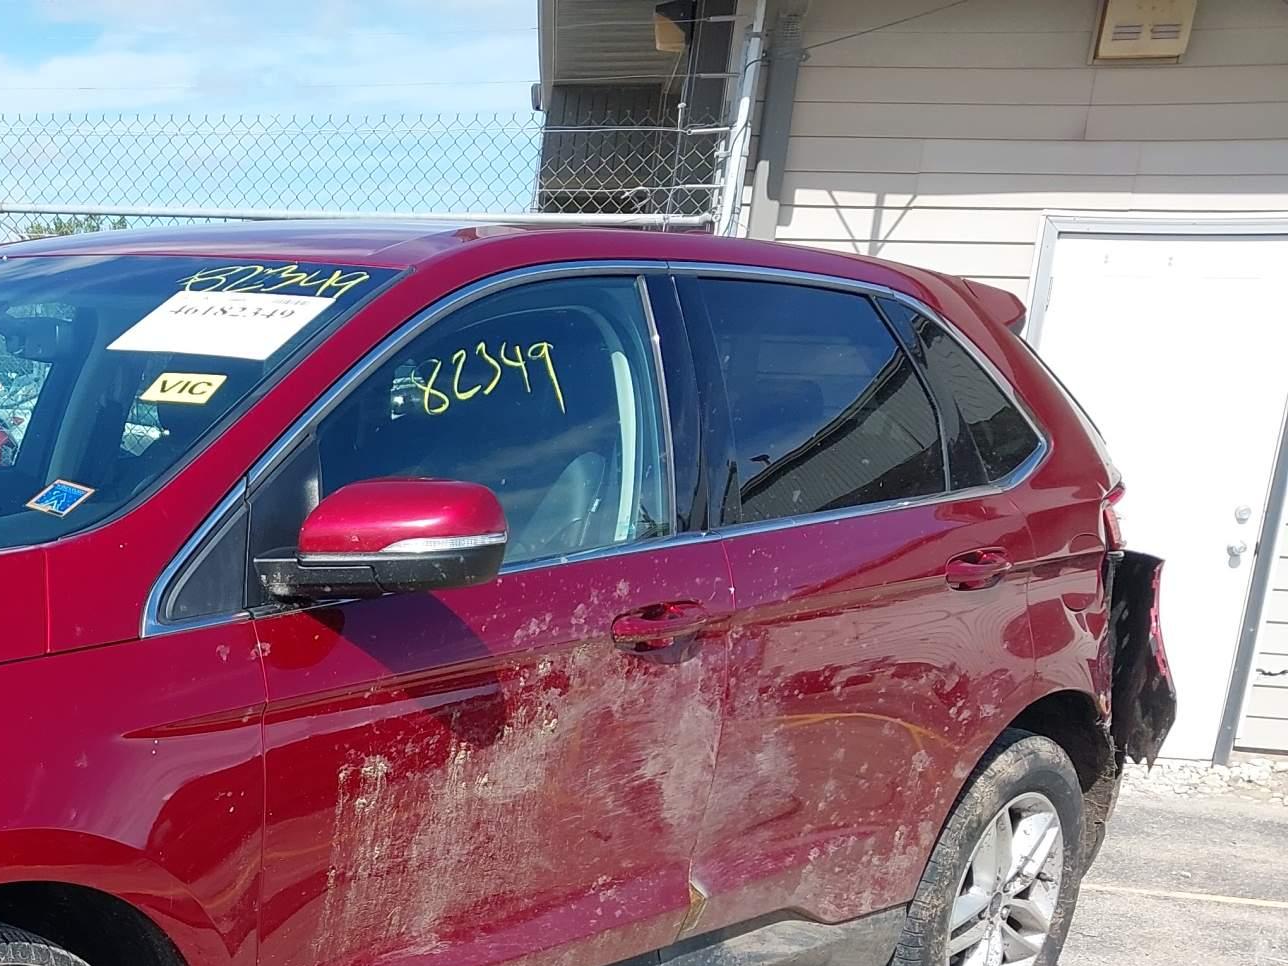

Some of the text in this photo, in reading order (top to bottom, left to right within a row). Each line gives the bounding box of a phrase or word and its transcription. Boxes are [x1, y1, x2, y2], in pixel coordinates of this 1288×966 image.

[178, 264, 370, 299] 82349
[159, 379, 213, 396] VIC
[412, 342, 566, 415] 82349
